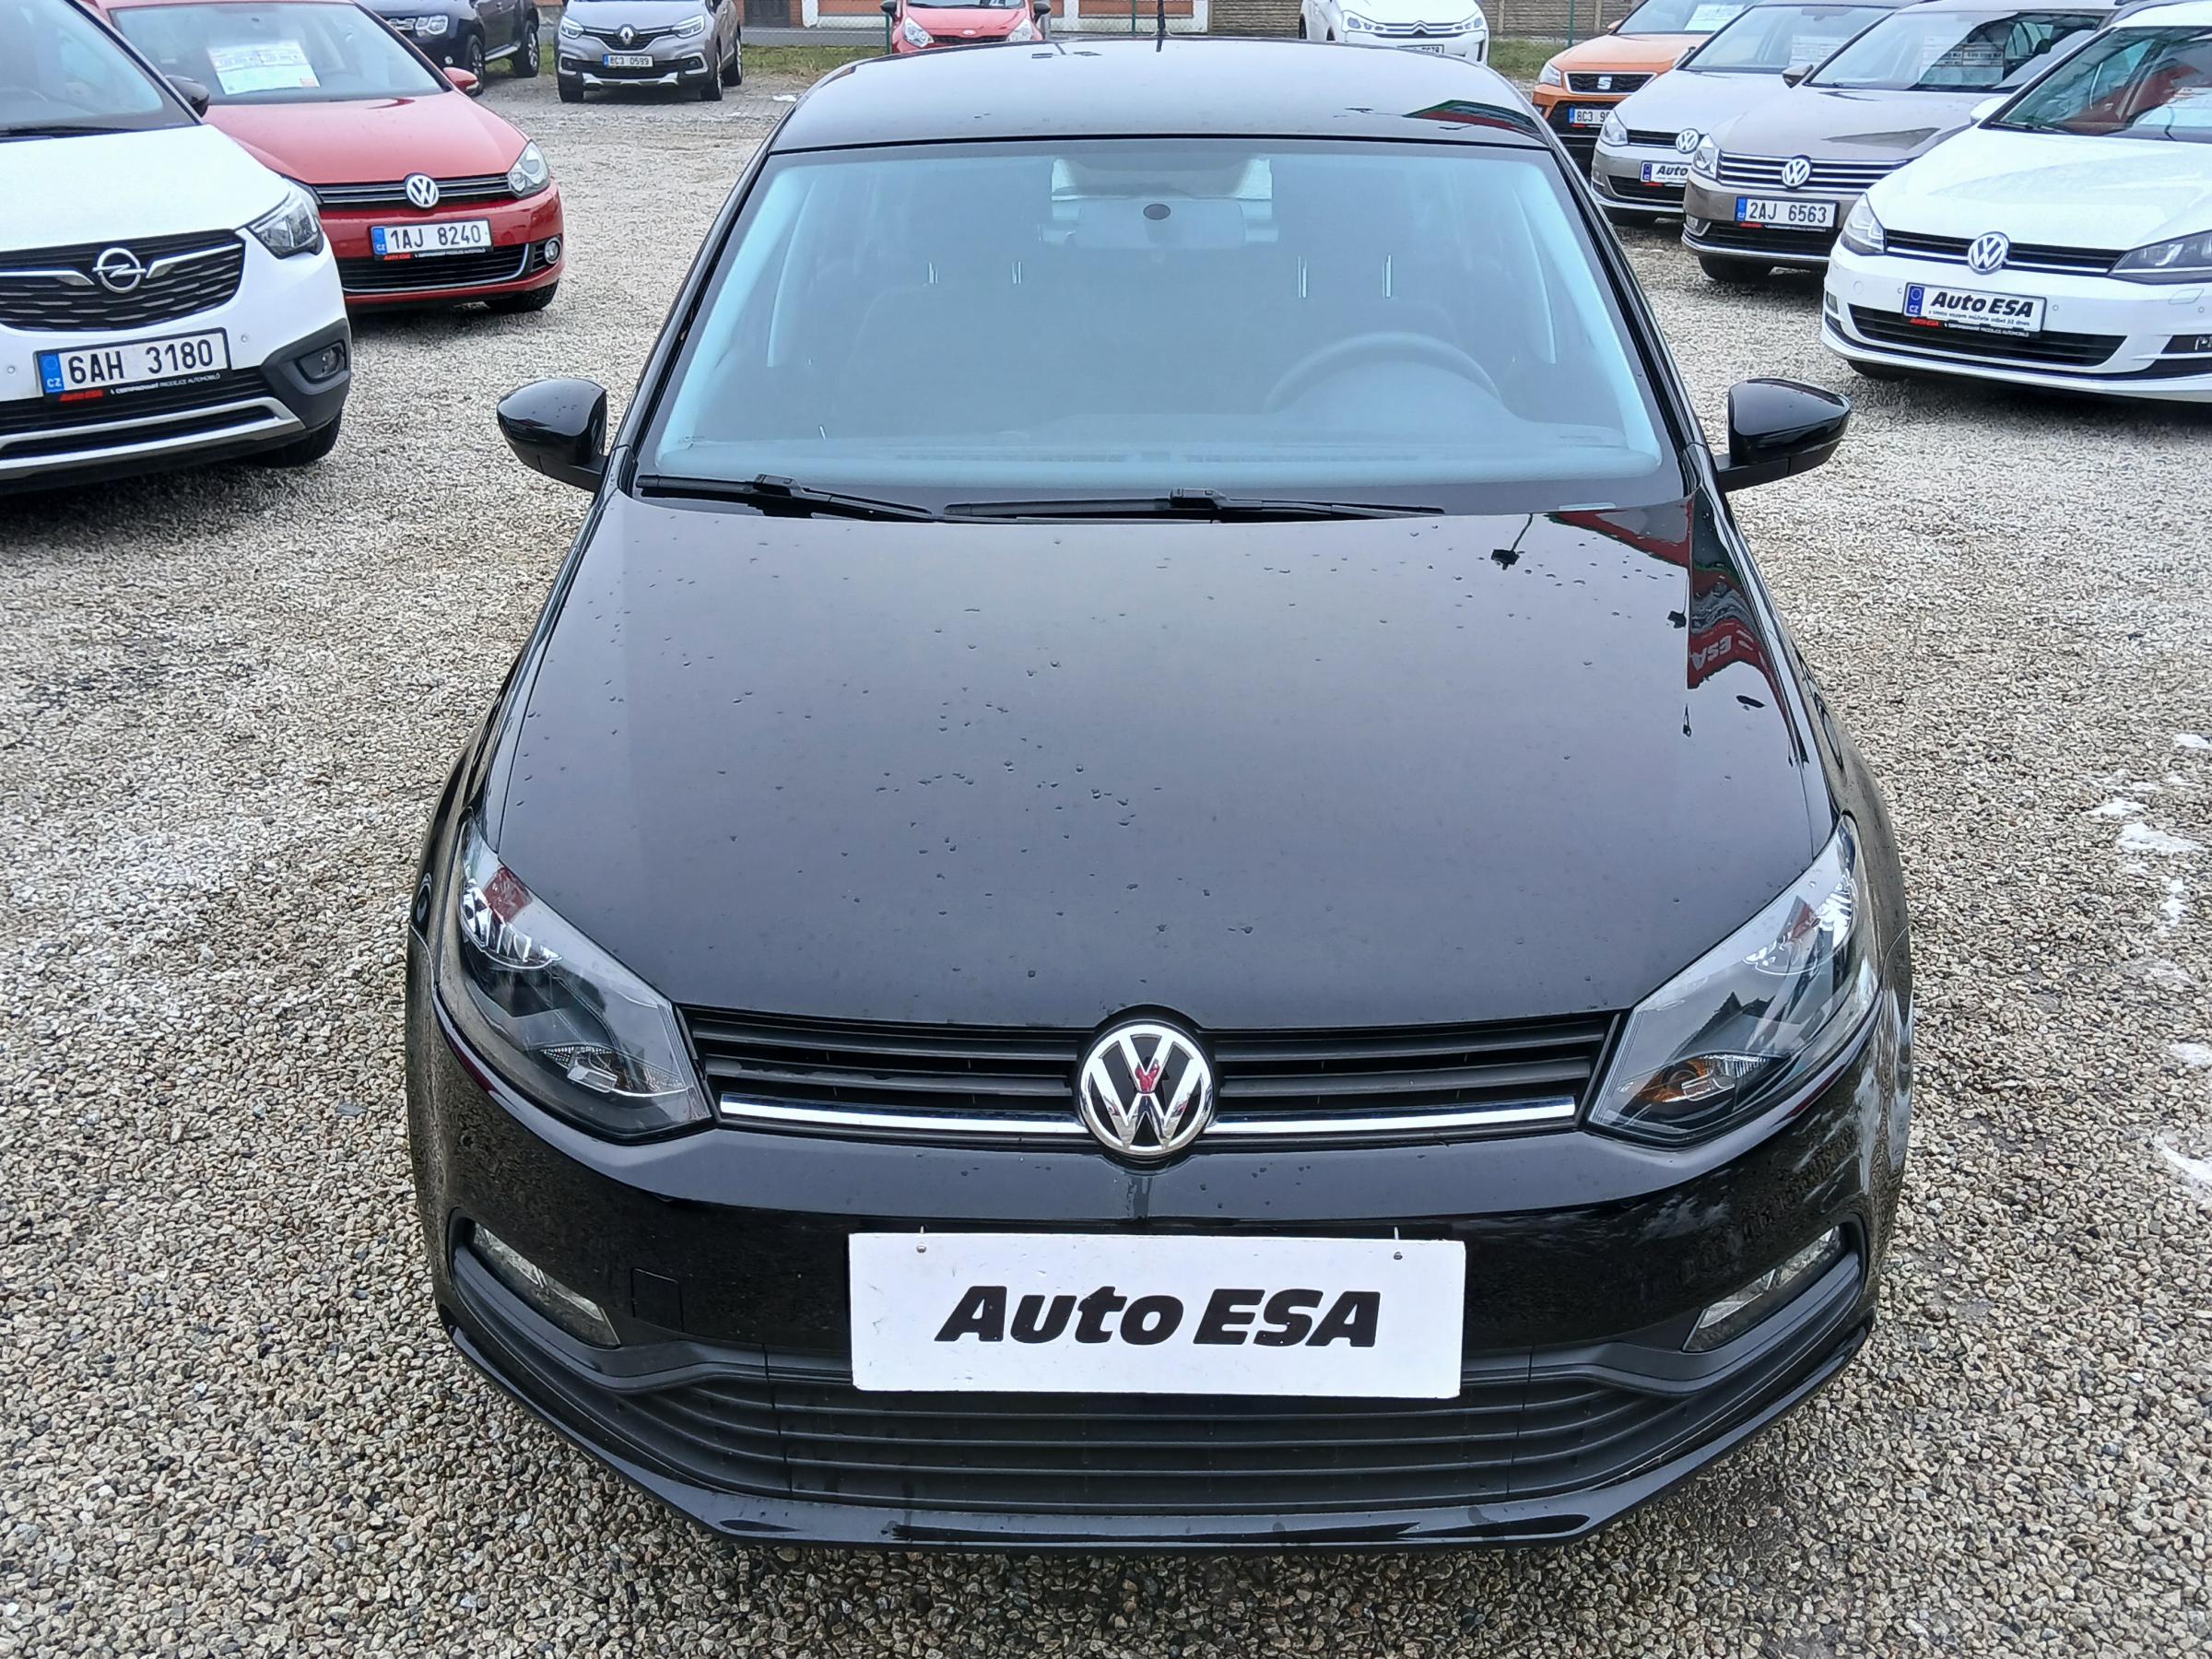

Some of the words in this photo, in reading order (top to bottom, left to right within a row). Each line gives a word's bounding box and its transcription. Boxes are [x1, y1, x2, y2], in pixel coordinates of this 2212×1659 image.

[1577, 111, 1593, 122] 8C3
[1656, 165, 1688, 176] Auto
[1749, 202, 1777, 219] 2AJ
[1788, 205, 1827, 223] 6563
[391, 228, 424, 249] 1AJ
[437, 225, 481, 246] 8240
[1909, 305, 1919, 313] CZ
[1930, 291, 1986, 312] Auto
[1988, 298, 2034, 318] ESA
[47, 377, 62, 388] CZ
[68, 351, 124, 384] 6AH
[146, 339, 213, 374] 3180
[934, 1286, 1184, 1346] Auto
[1193, 1288, 1381, 1348] ESA
